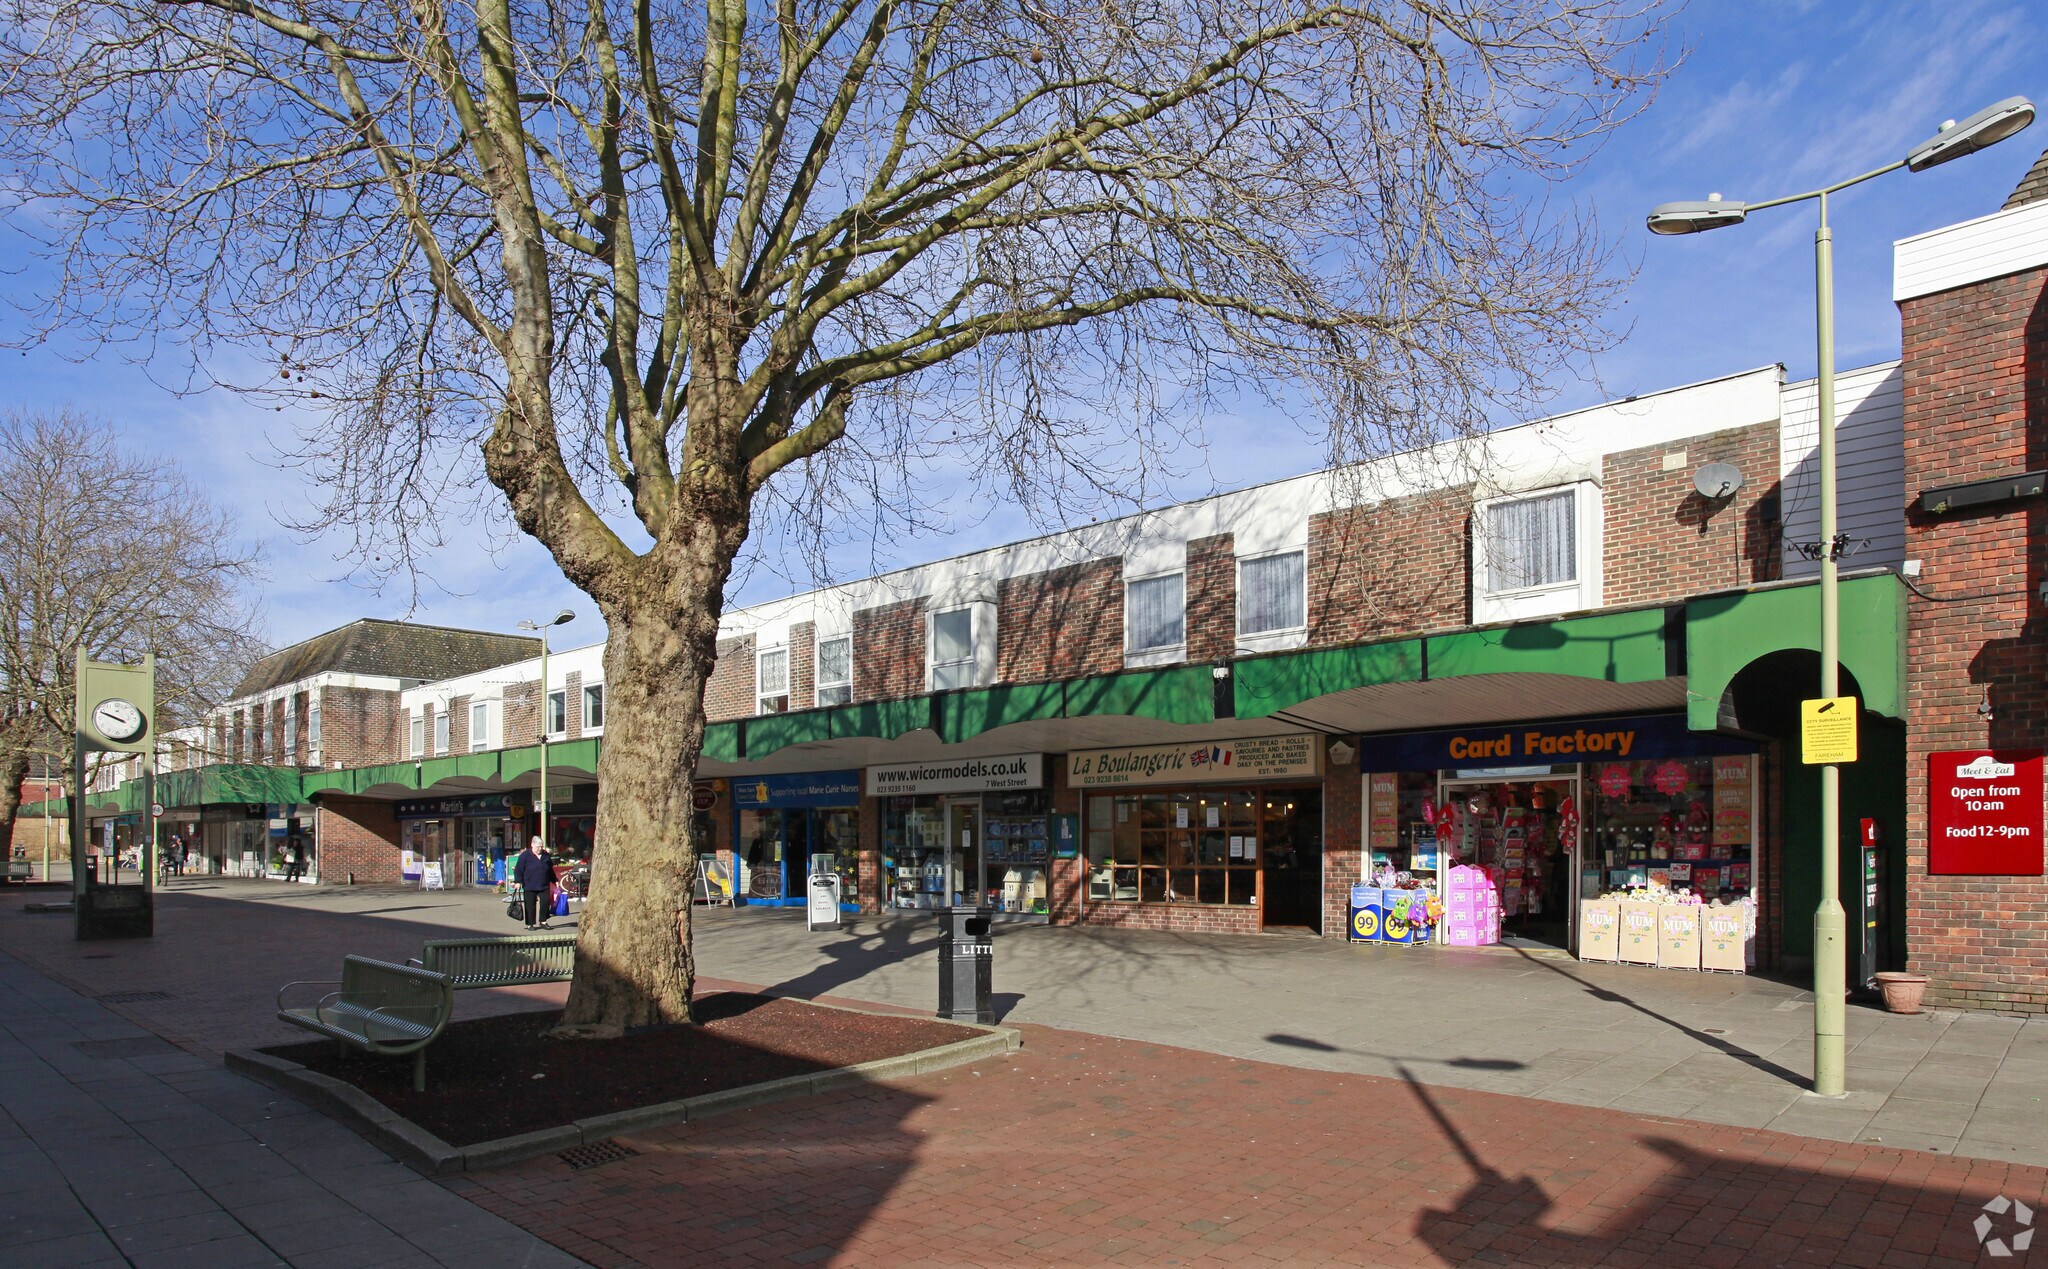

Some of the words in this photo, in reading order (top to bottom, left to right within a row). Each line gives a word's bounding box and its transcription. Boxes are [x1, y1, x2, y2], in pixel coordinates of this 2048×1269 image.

[1282, 744, 1310, 752] PASTRIES
[1449, 734, 1511, 759] Card
[1525, 730, 1635, 756] Factory
[1073, 757, 1091, 775] La
[1097, 748, 1186, 776] Boulangerie
[877, 758, 1027, 782] www.wicormodels.co.uk
[1716, 768, 1747, 780] MUM
[1961, 767, 1982, 776] Meet
[1984, 766, 1992, 774] &
[1994, 766, 2010, 774] Eat
[986, 780, 990, 788] 7
[990, 780, 1006, 788] West
[1007, 778, 1027, 787] Street
[1084, 776, 1096, 784] 023
[770, 788, 796, 798] Supporting
[796, 787, 808, 796] local
[808, 786, 824, 794] Marie
[825, 785, 839, 794] Curie
[841, 784, 859, 792] Nurses
[876, 786, 886, 794] 023
[902, 784, 916, 792] 1160
[1373, 783, 1395, 792] MUM
[1951, 786, 1984, 800] Open
[1988, 784, 2020, 796] from
[440, 800, 464, 812] Martin's
[1946, 826, 1977, 838] Food
[1978, 826, 2030, 838] 12-9pm
[1587, 914, 1613, 924] MUM
[1626, 916, 1653, 926] MUM
[1664, 920, 1693, 931] MUM
[1708, 920, 1738, 932] MUM
